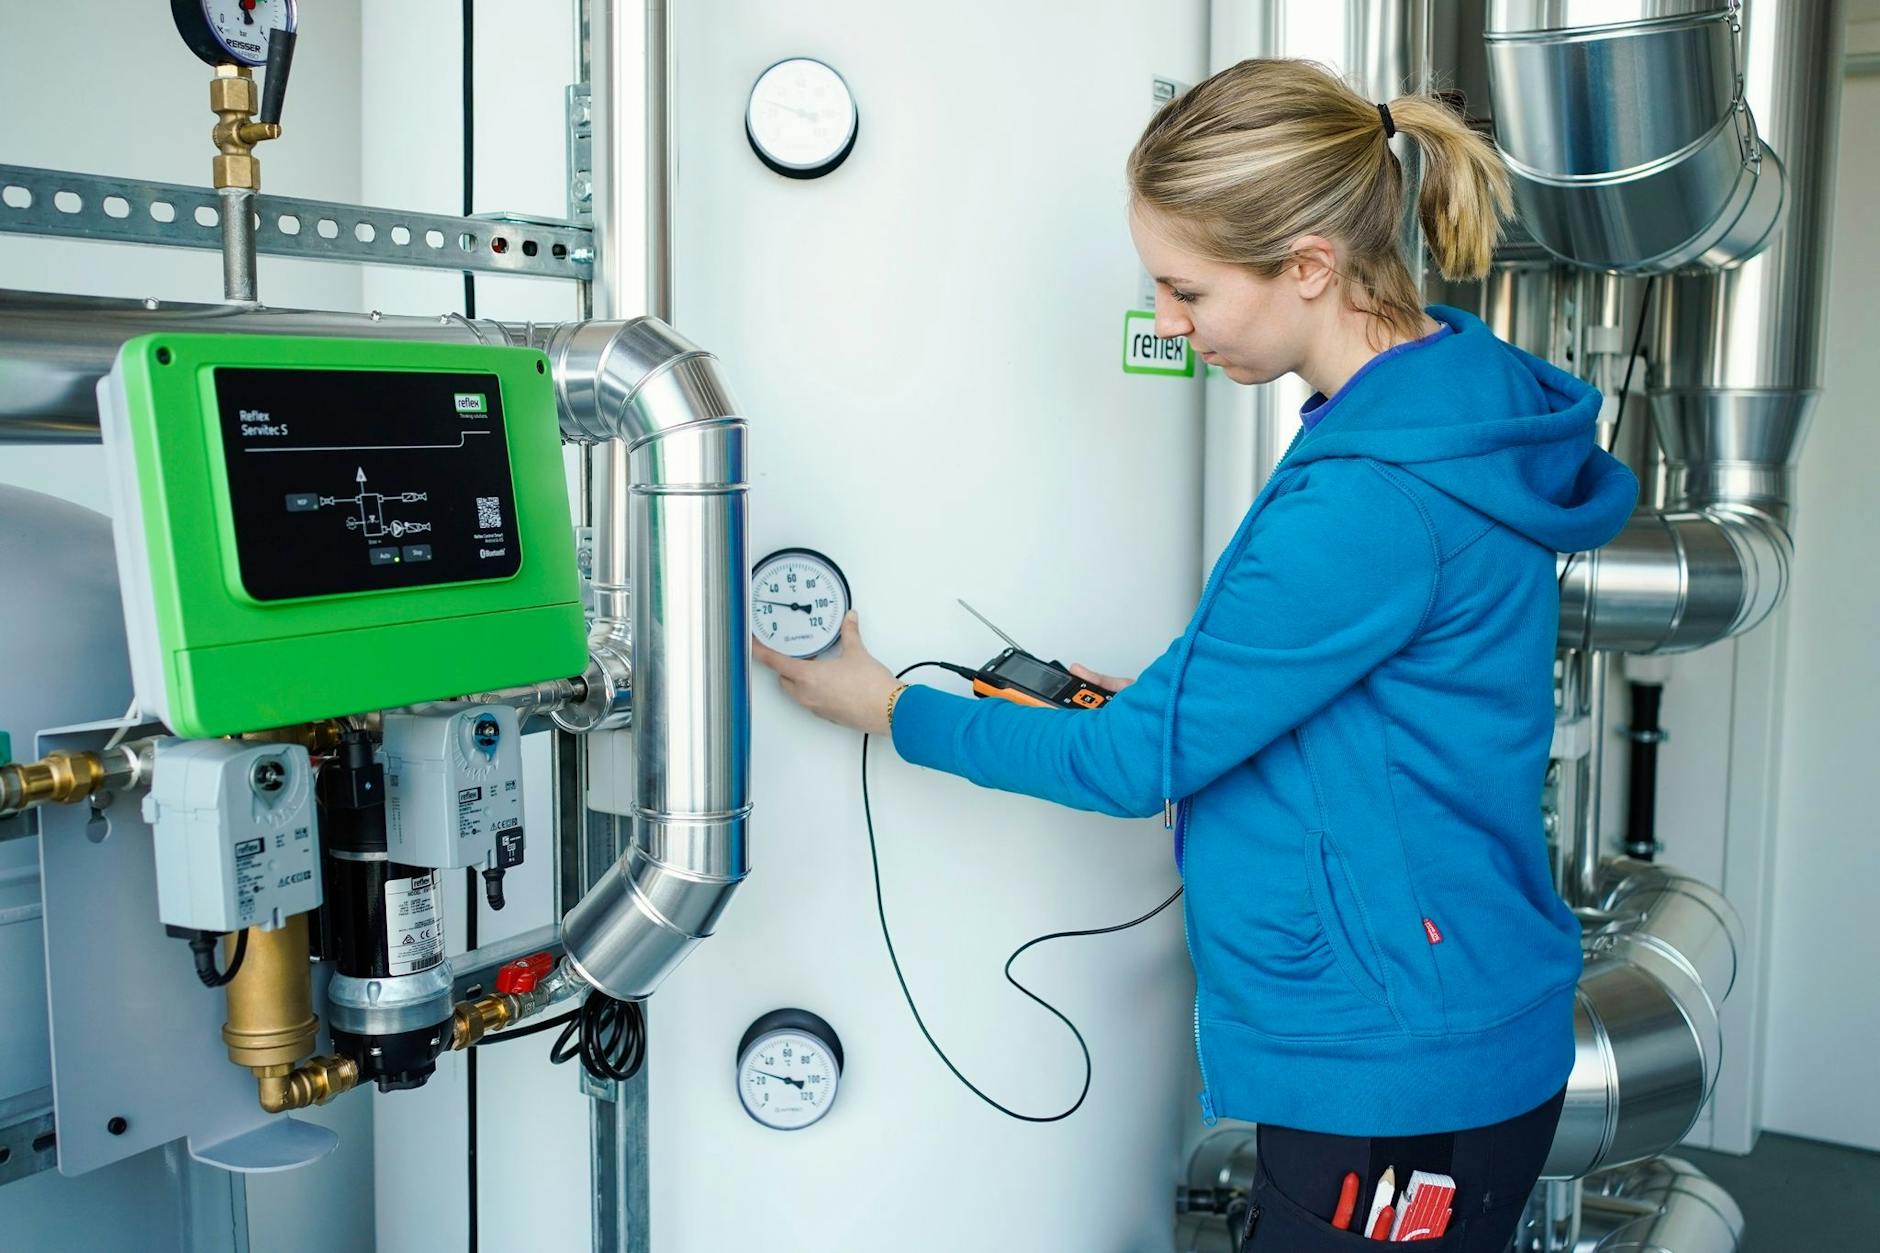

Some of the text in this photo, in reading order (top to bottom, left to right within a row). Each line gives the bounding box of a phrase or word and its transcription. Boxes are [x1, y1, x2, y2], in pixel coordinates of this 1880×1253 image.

[220, 13, 225, 23] 0
[226, 38, 262, 53] REISSER
[458, 397, 480, 408] reflex
[239, 409, 271, 422] Reflex
[241, 423, 289, 436] Servitec S
[786, 573, 797, 583] 60
[769, 583, 779, 593] 40
[806, 579, 816, 589] 80
[815, 598, 828, 608] 100
[763, 604, 773, 614] 20
[772, 622, 778, 631] 0
[809, 616, 823, 627] 120
[460, 791, 477, 801] reflex
[413, 878, 430, 888] reflex
[420, 928, 431, 940] CE
[783, 1048, 793, 1058] 60
[764, 1056, 775, 1066] 40
[800, 1055, 811, 1065] 80
[756, 1076, 766, 1085] 20
[807, 1074, 820, 1084] 100
[764, 1092, 769, 1102] 0
[800, 1091, 814, 1101] 120
